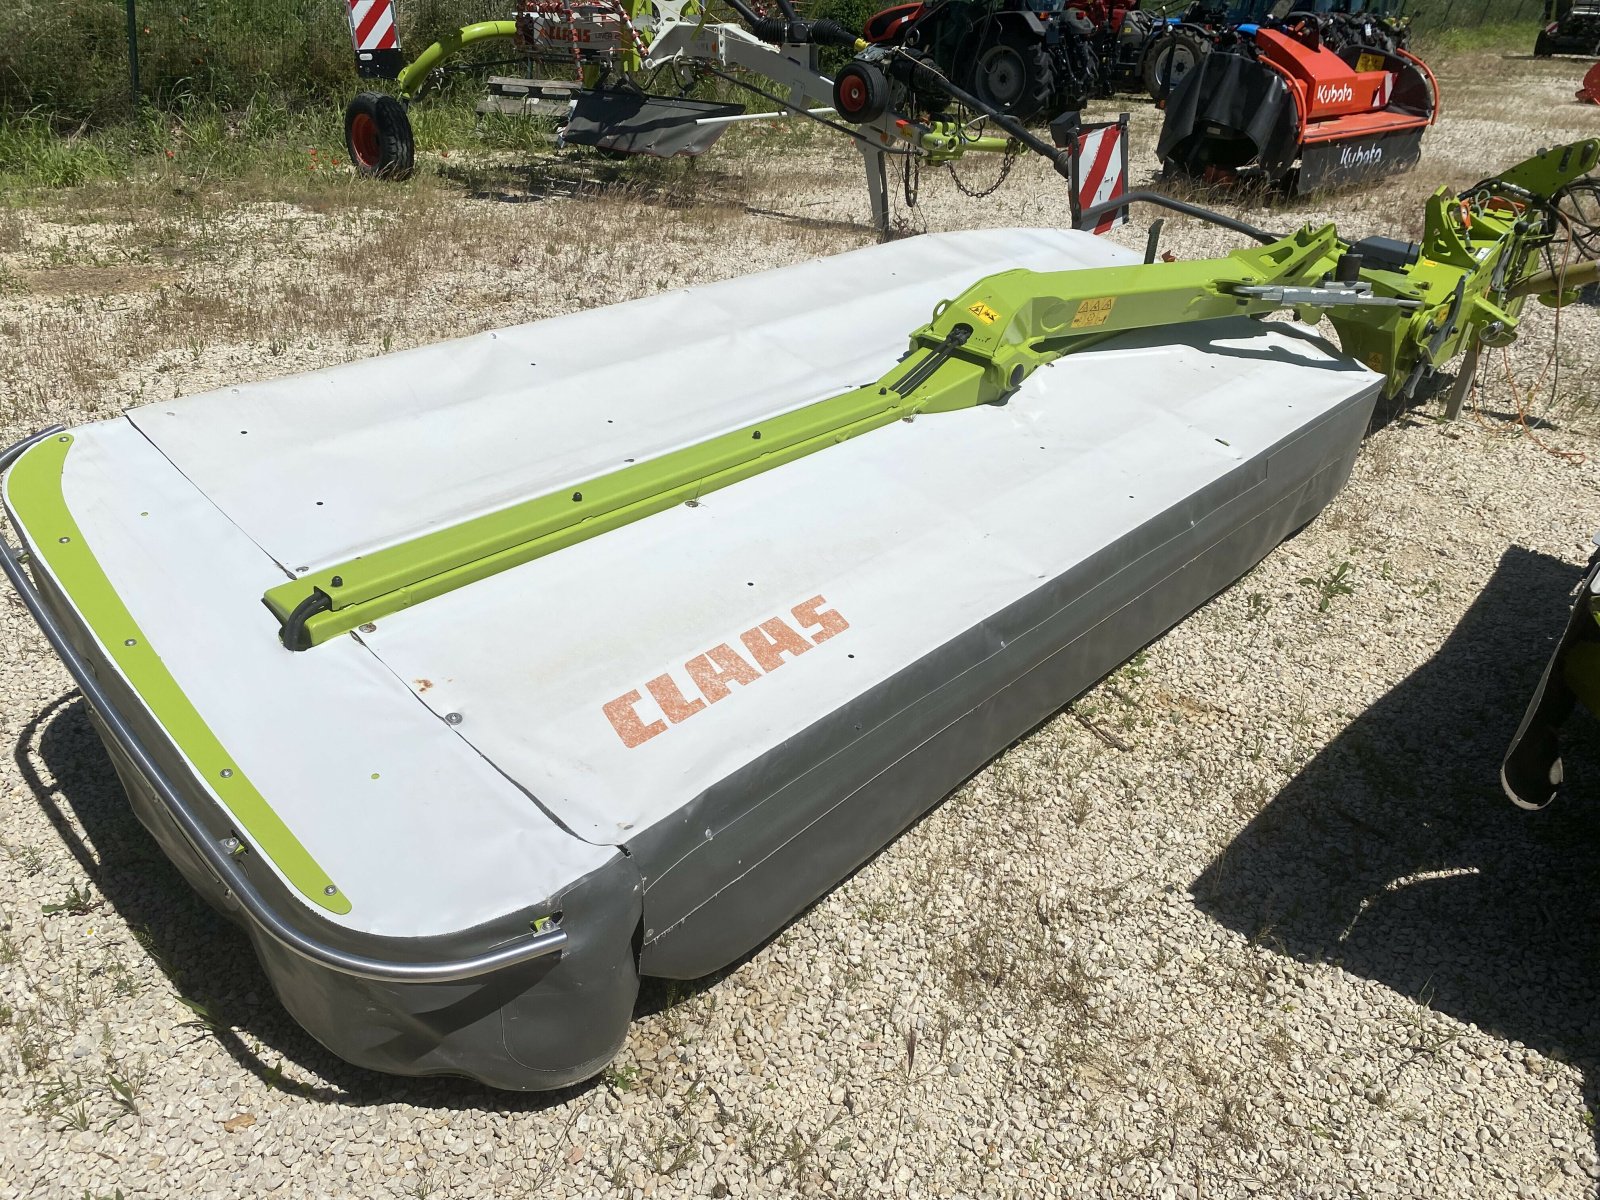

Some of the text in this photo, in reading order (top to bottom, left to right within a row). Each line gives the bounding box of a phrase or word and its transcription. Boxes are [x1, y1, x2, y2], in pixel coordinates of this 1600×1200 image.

[1317, 83, 1352, 104] Kubota
[1340, 143, 1382, 168] Kubota
[602, 594, 850, 749] CLAAS
